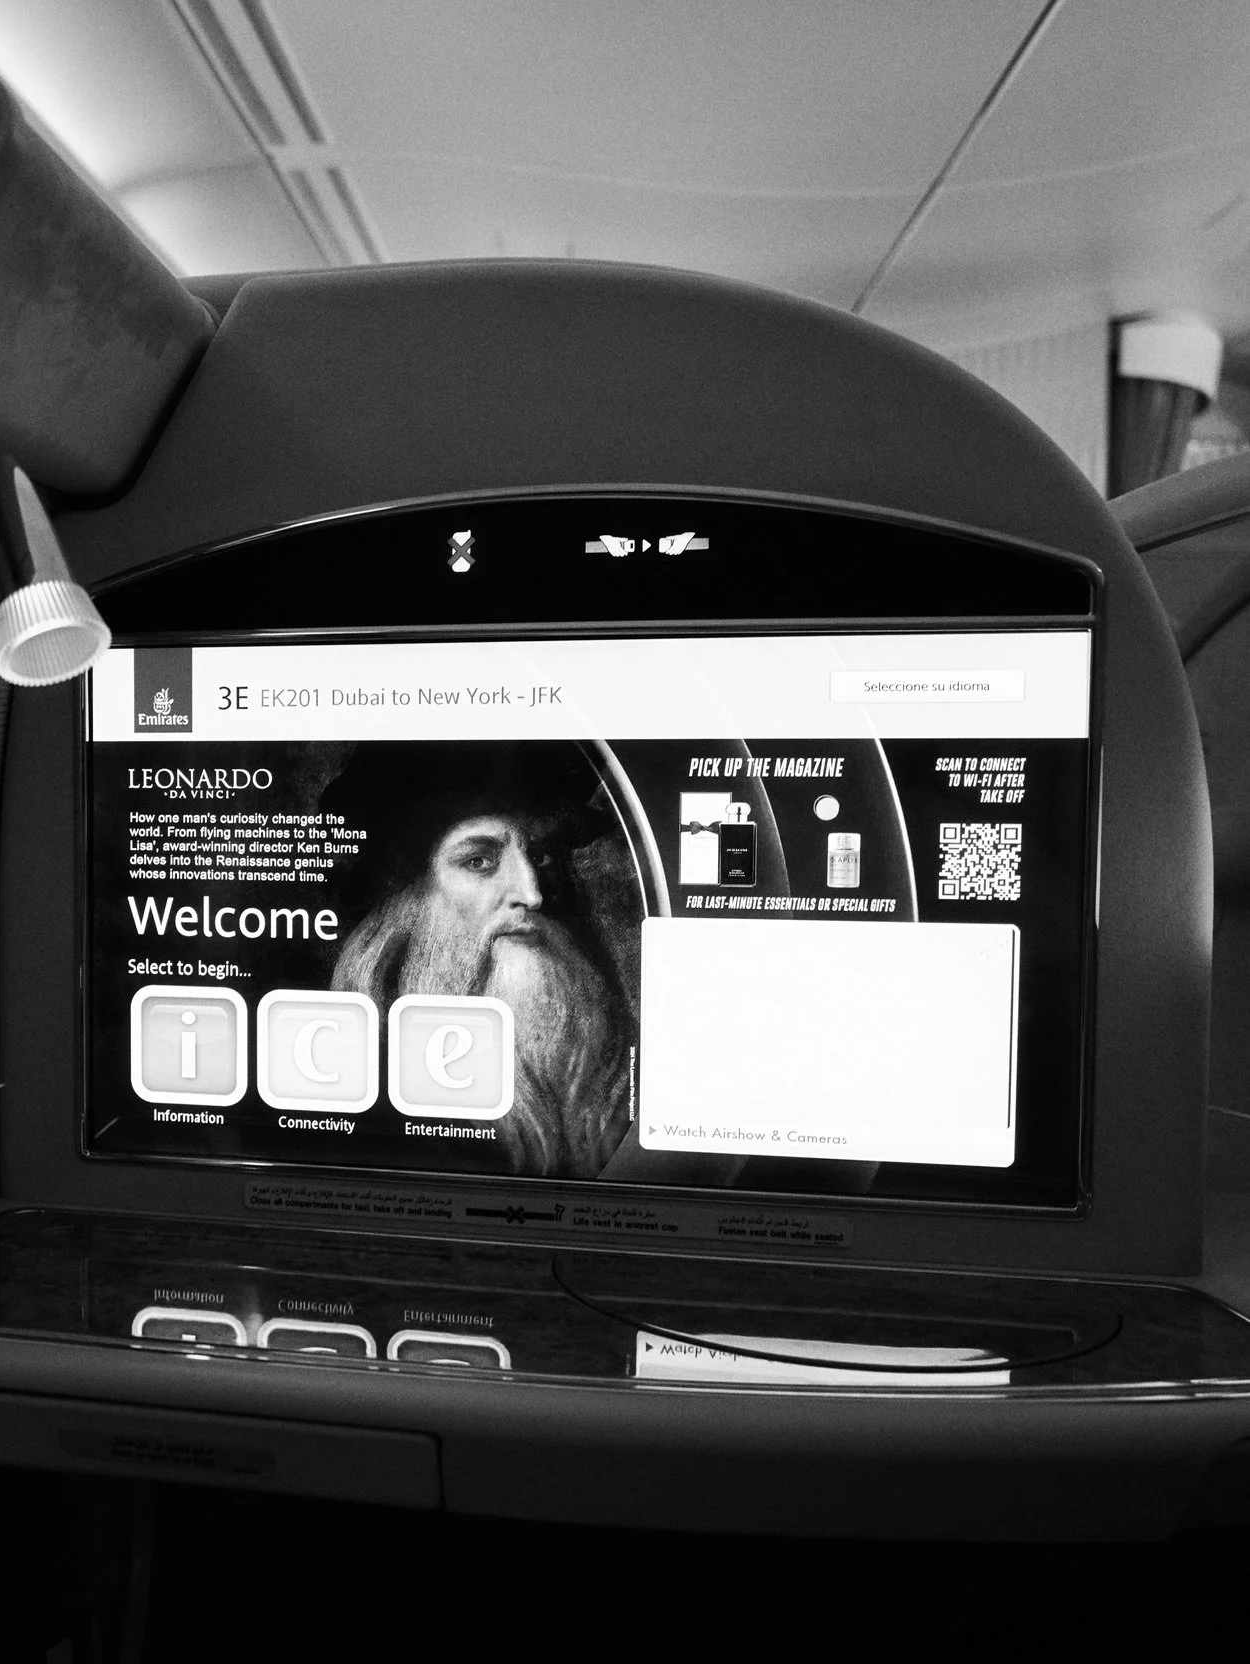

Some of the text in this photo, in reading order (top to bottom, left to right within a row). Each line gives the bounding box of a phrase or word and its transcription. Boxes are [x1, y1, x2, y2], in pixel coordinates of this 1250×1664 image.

[863, 680, 991, 693] Seleccione su idioma
[218, 685, 248, 710] 3E
[261, 688, 318, 707] EK201
[332, 687, 385, 706] Dubai
[391, 689, 410, 705] to
[418, 688, 460, 705] New
[466, 686, 511, 705] York
[529, 686, 562, 707] JFK
[137, 713, 189, 726] Emirates
[688, 757, 844, 777] PICK UP THE MAGAZINE
[935, 757, 1026, 771] SCAN TO CONNECT
[128, 768, 273, 789] LEONARDO
[948, 773, 1025, 787] TO WI-FI AFTER
[980, 789, 1025, 803] TAKE OFF
[129, 811, 345, 827] How one man's curiosity changed the
[129, 825, 163, 837] world.
[167, 825, 196, 837] From
[199, 826, 231, 840] flying
[234, 826, 290, 839] machines
[293, 827, 305, 839] to
[308, 827, 327, 839] the
[162, 840, 245, 855] award-winning
[248, 841, 294, 853] director
[297, 841, 320, 853] Ken
[324, 841, 359, 854] Burns
[129, 853, 334, 869] delves into the Renaissance genius
[129, 867, 327, 882] whose innovations transcend time.
[686, 895, 896, 912] FOR LAST-MINUTE ESSENTIALS OR SPECIAL GIFTS
[127, 895, 338, 940] Welcome
[127, 957, 252, 981] Select to begin...
[153, 1108, 224, 1124] Information
[278, 1115, 355, 1134] Connectivity
[405, 1121, 496, 1139] Entertainment
[663, 1124, 847, 1145] Watch Airshow & Cameras
